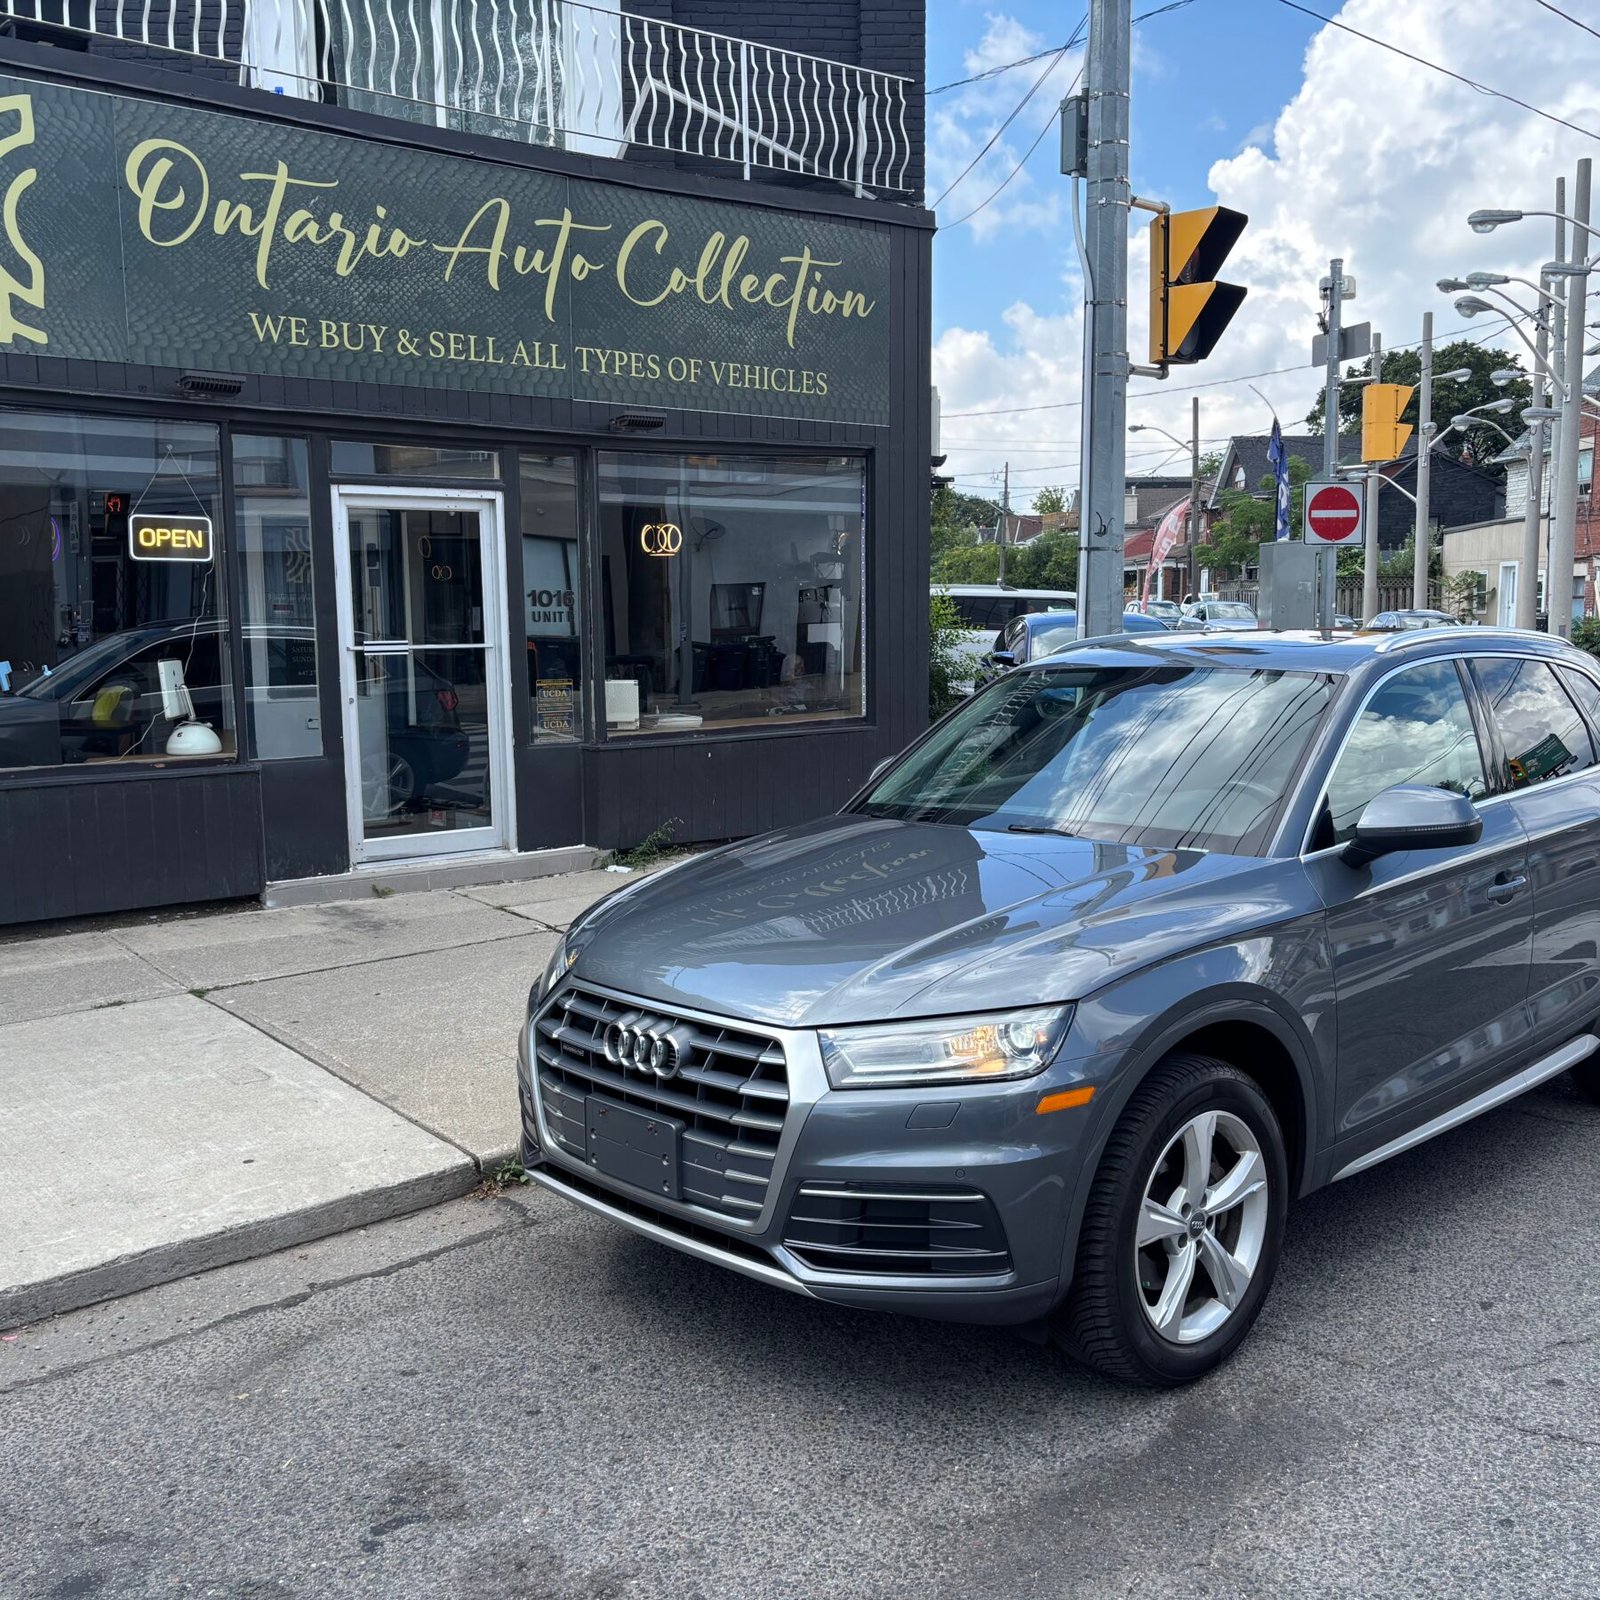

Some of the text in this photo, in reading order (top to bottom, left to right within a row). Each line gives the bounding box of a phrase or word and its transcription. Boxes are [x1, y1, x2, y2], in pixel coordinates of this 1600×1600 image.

[125, 138, 876, 349] Ontario Auto Collection
[248, 312, 829, 396] WE BUY & SELL ALL TYPES OF VEHICLES
[139, 527, 203, 548] OPEN
[527, 589, 575, 608] 1016
[532, 610, 564, 623] UNIT
[543, 690, 567, 698] UCDA
[544, 720, 569, 729] UCDA
